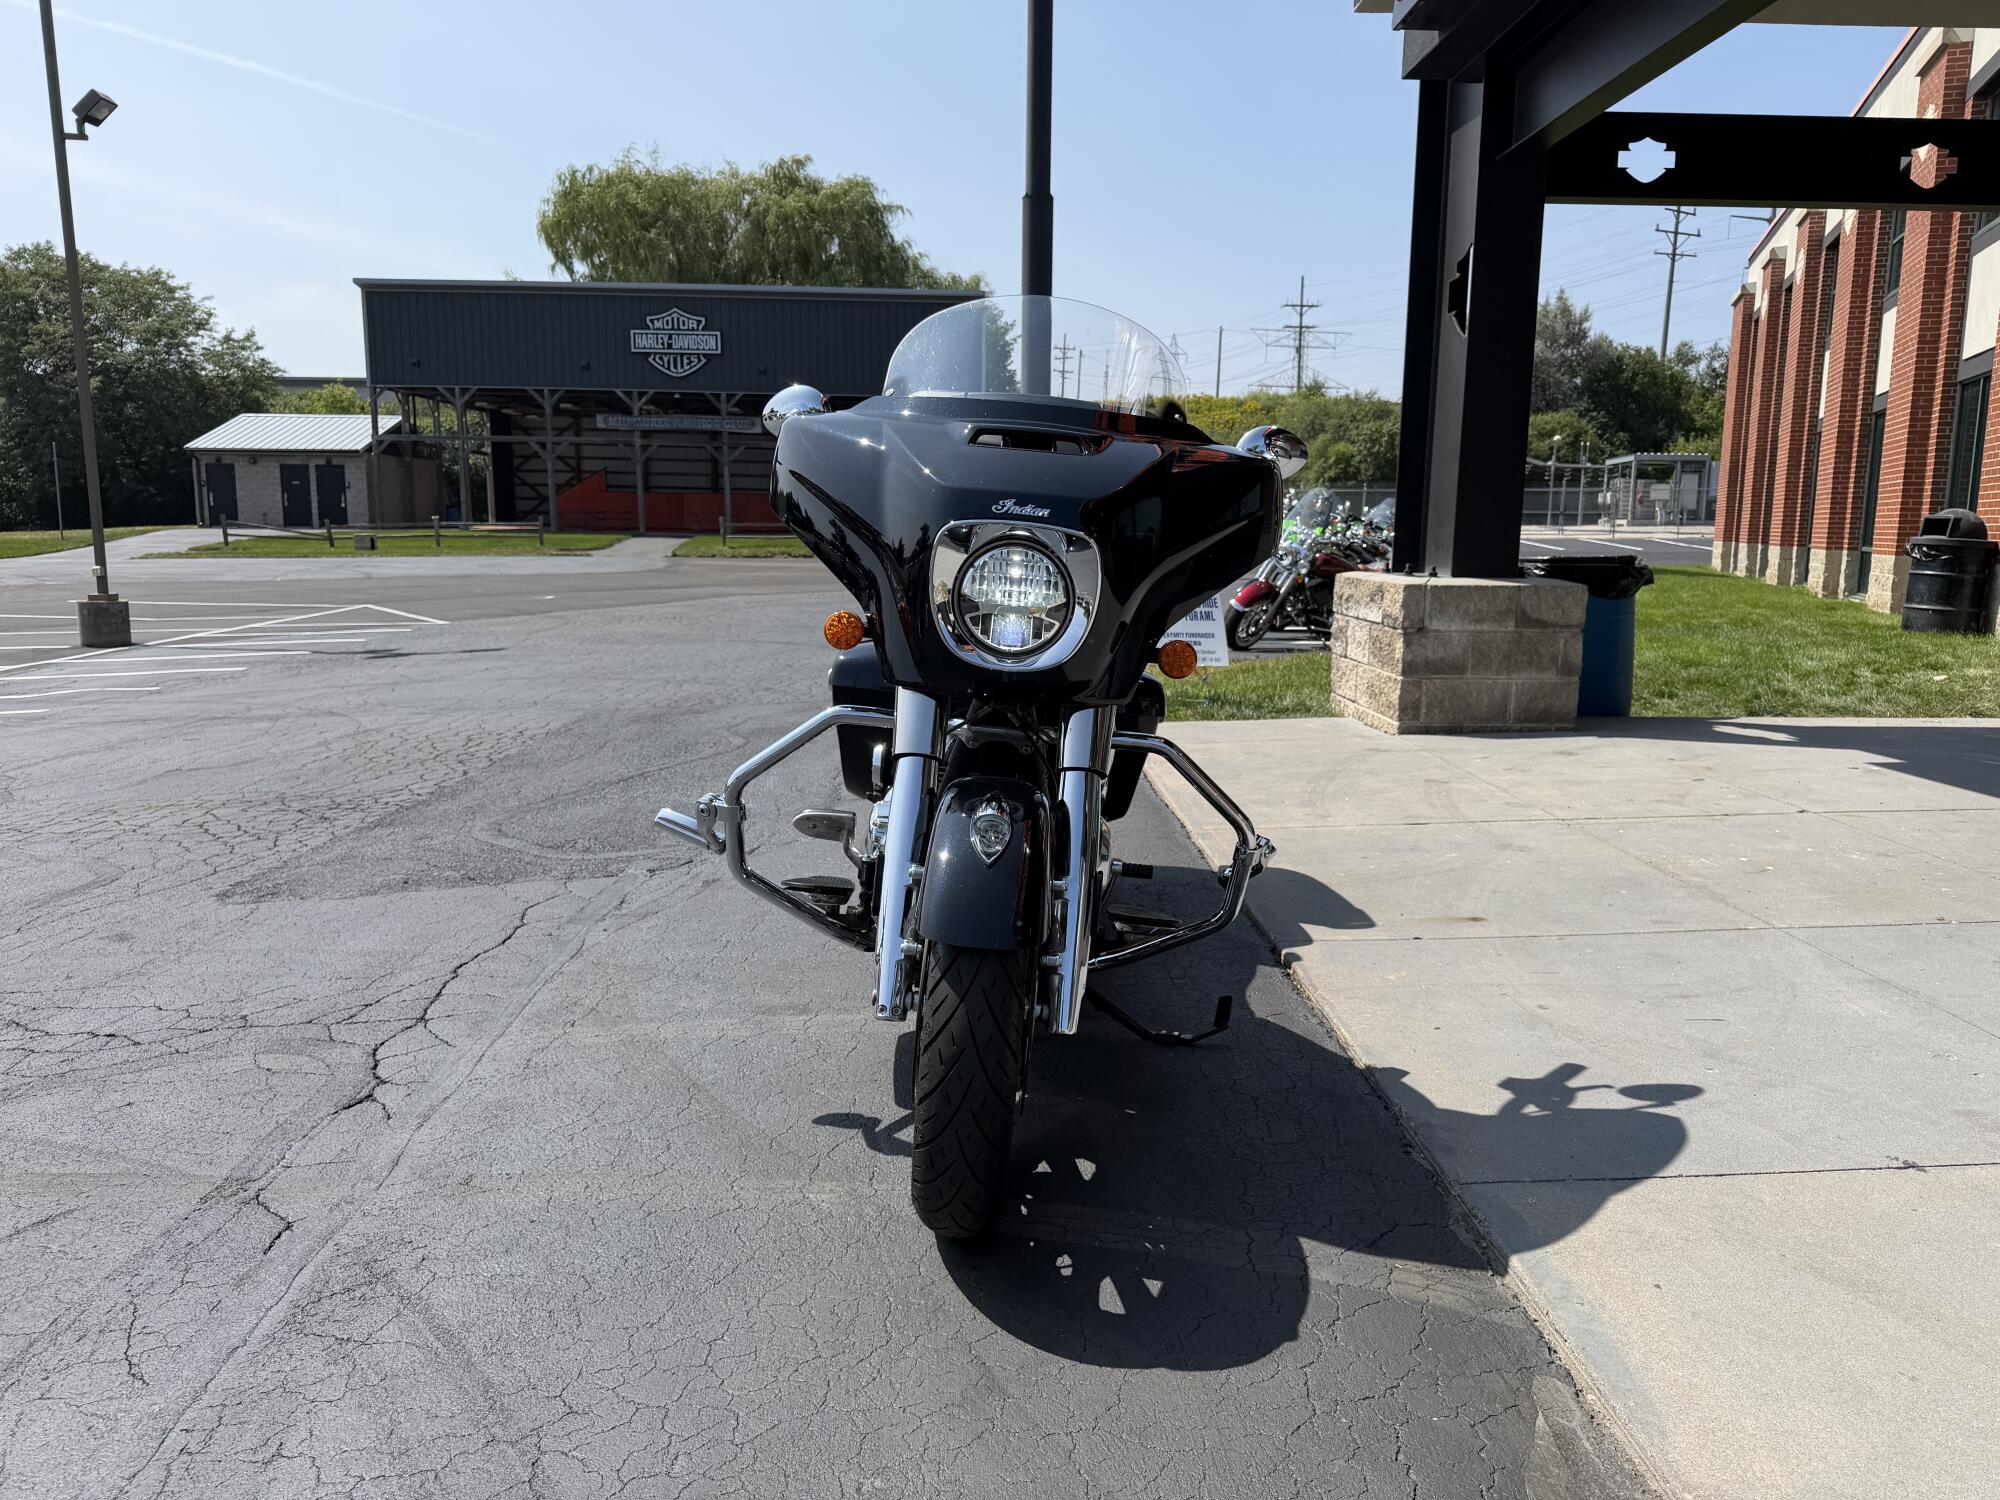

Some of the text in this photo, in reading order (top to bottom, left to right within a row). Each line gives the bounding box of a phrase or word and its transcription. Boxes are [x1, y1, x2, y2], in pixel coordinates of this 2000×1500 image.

[653, 312, 698, 330] MOTOR
[635, 334, 717, 350] HARLEY-DAVIDSON
[655, 354, 699, 373] CYCLES
[991, 498, 1051, 517] Indian
[1199, 610, 1216, 621] AML
